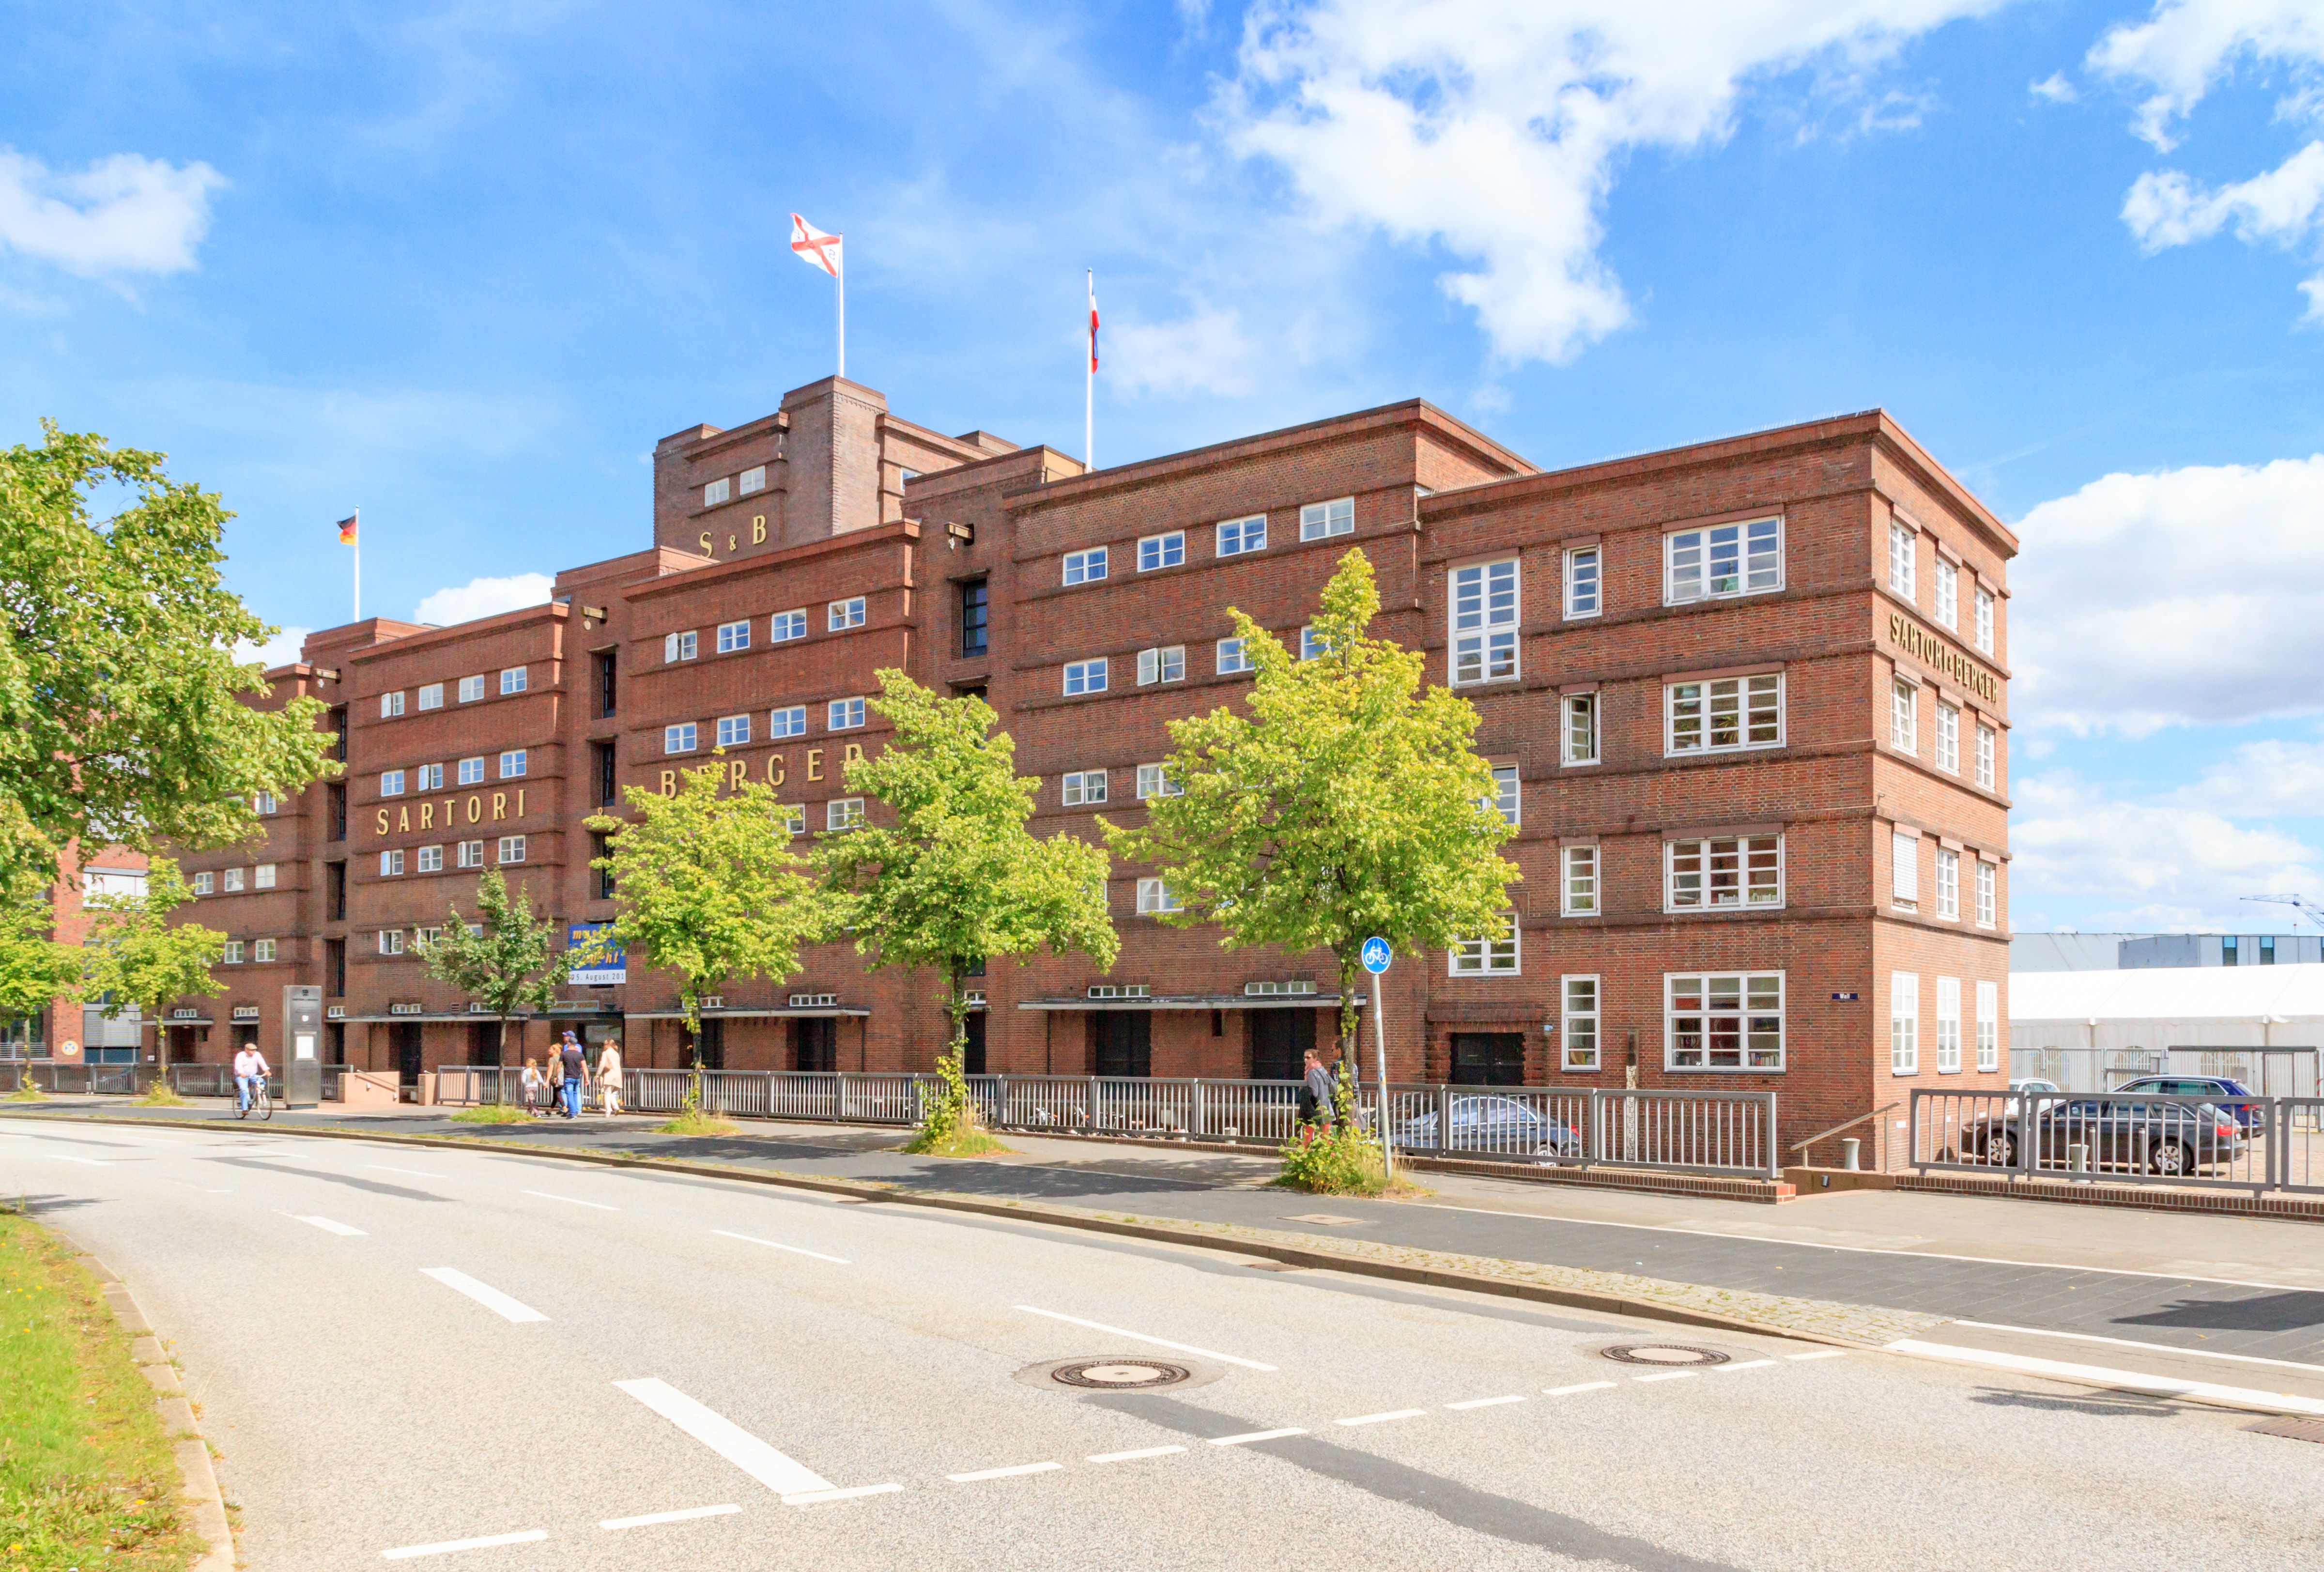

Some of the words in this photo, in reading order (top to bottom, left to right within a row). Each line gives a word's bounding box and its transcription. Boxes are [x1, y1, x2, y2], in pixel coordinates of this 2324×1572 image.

[700, 532, 713, 558] S
[729, 535, 737, 551] &
[753, 515, 767, 545] B
[1891, 612, 1947, 672] SARTORI
[1948, 655, 1954, 671] &
[1955, 654, 1999, 703] BERGER
[376, 789, 525, 835] SARTORI
[660, 743, 863, 799] BRGER
[585, 973, 609, 982] August
